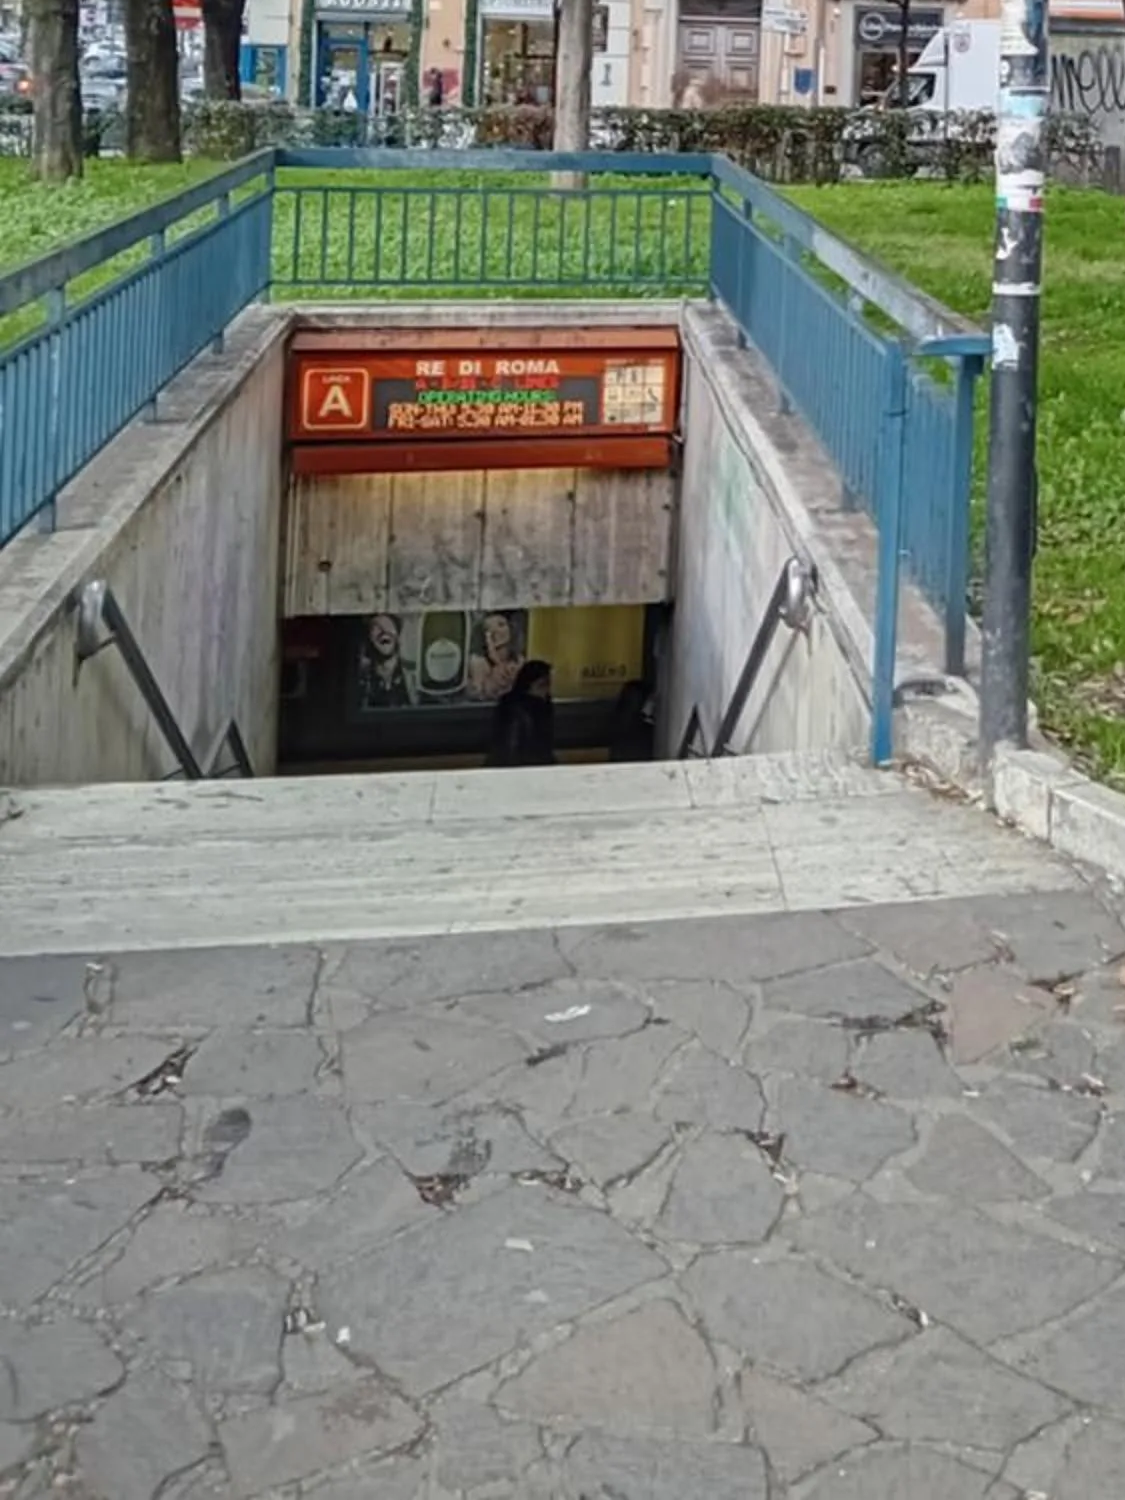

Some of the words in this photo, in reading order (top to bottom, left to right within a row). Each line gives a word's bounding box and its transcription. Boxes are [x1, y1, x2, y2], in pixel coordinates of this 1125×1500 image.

[416, 359, 446, 376] RE
[459, 359, 481, 376] DI
[495, 359, 561, 376] ROMA
[318, 384, 353, 418] A
